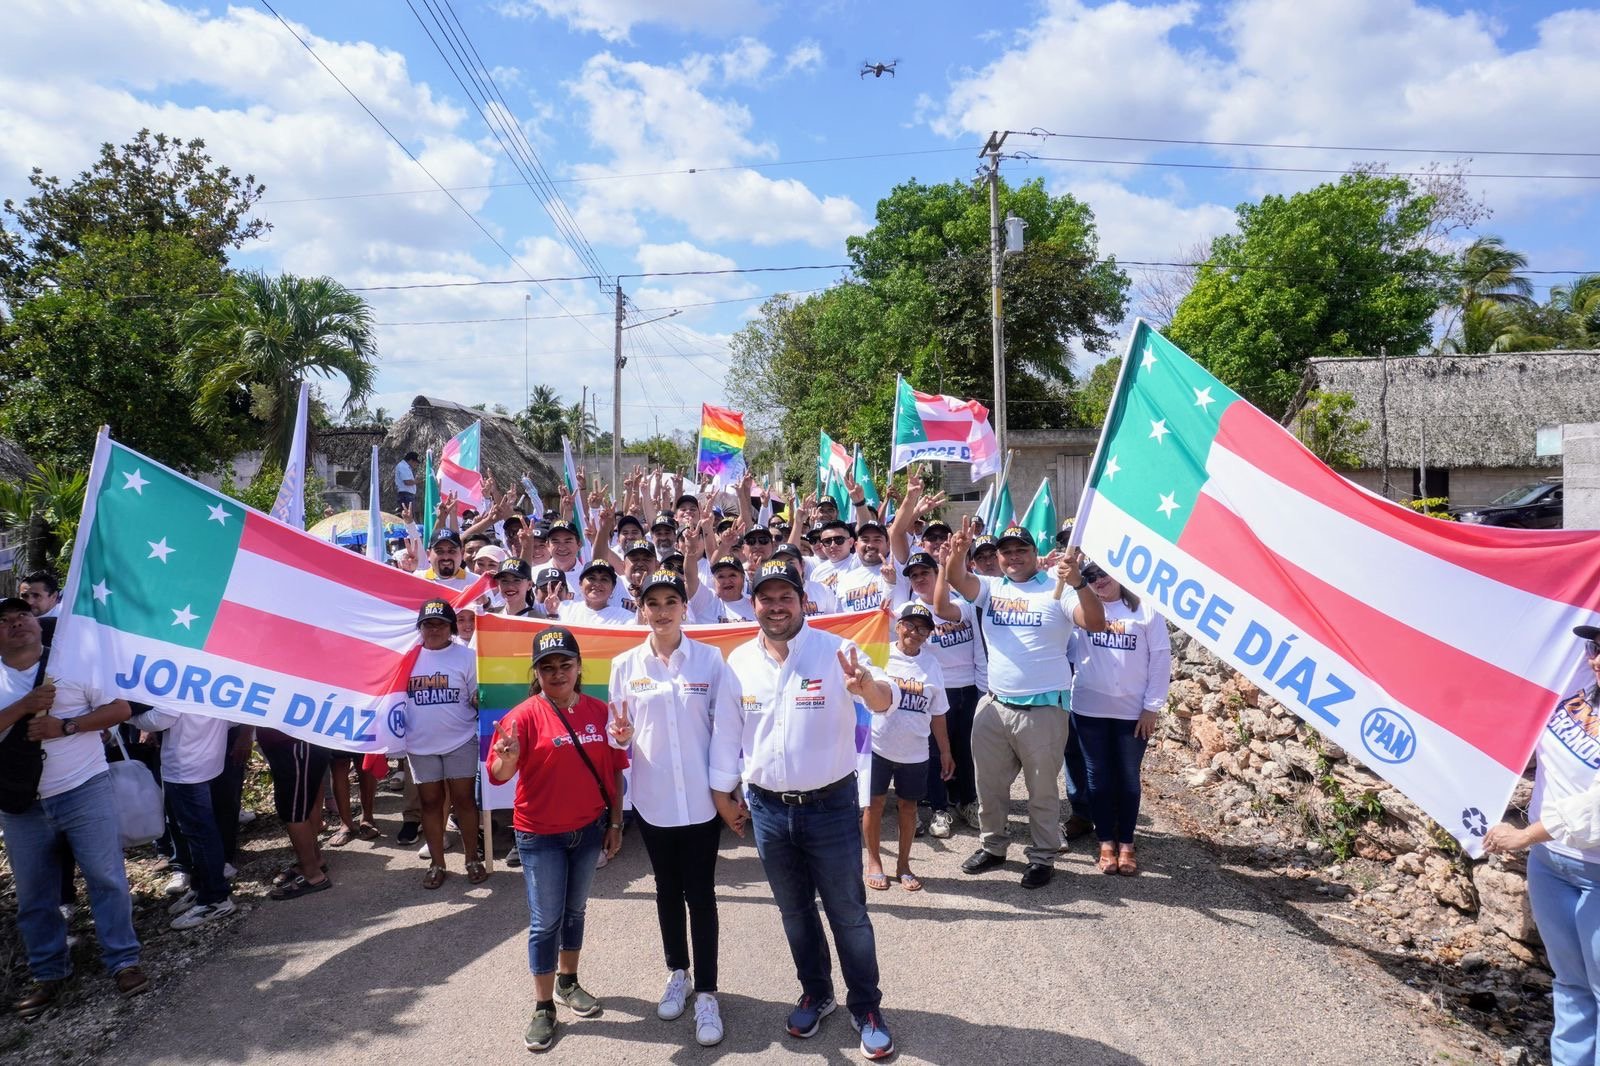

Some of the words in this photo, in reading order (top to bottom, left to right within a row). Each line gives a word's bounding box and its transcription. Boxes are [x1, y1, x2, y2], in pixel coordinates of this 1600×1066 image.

[993, 610, 1042, 626] GRANDE
[1107, 534, 1235, 642] JORGE
[1233, 619, 1356, 728] DÍAZ
[1092, 631, 1137, 650] GRANDE
[115, 654, 276, 717] JORGE
[282, 692, 377, 742] DÍAZ
[414, 688, 460, 706] GRANDE
[1364, 712, 1412, 760] PAN
